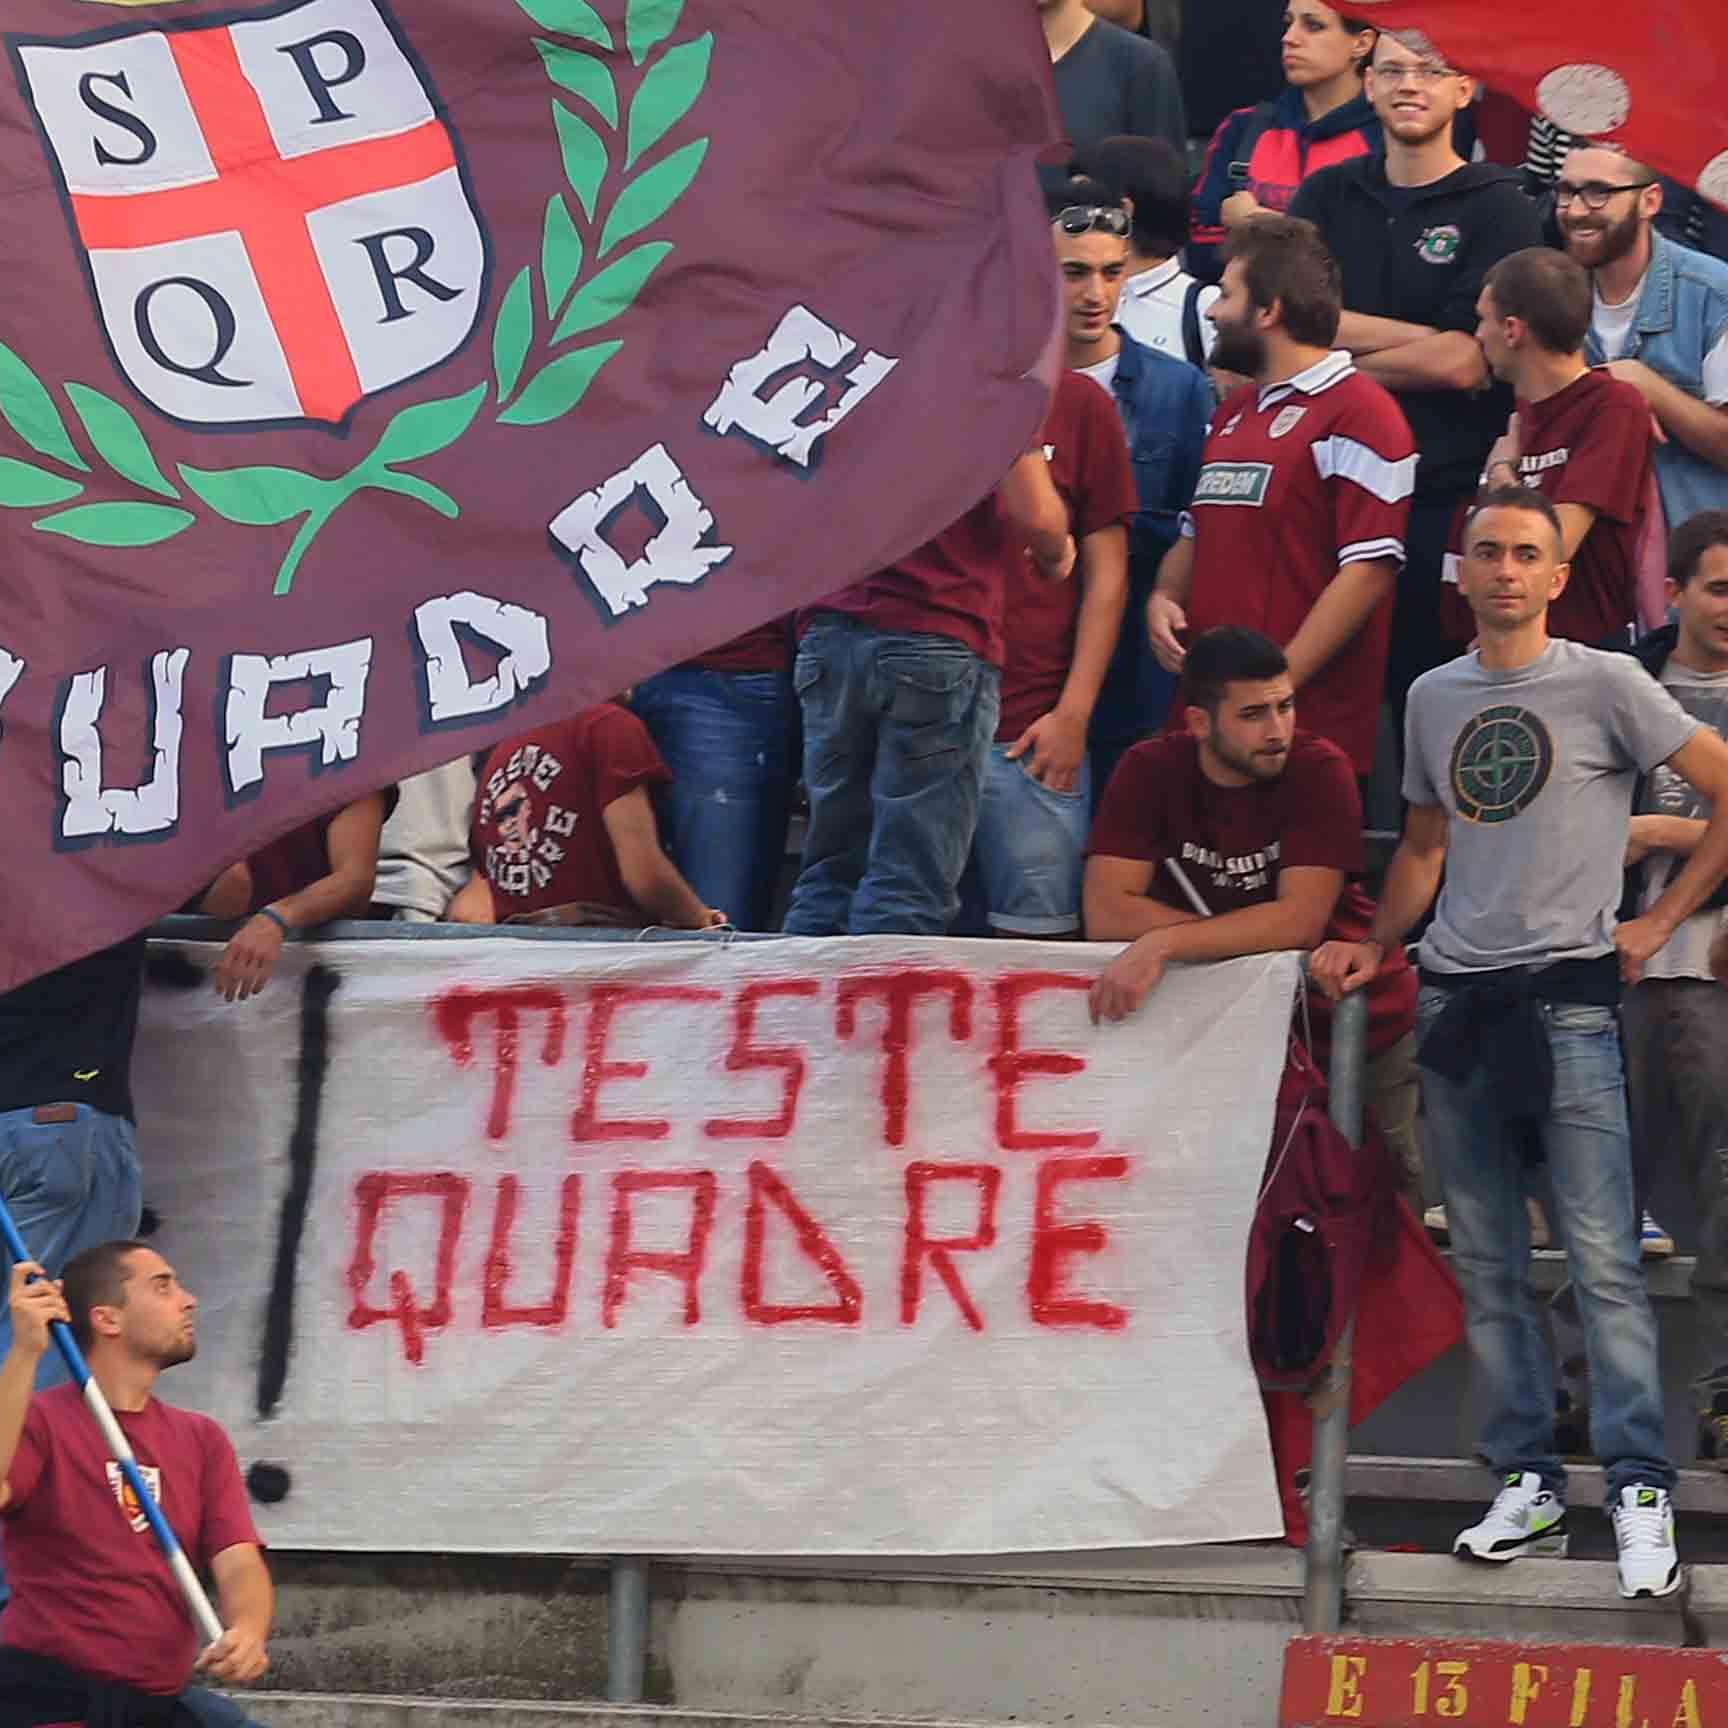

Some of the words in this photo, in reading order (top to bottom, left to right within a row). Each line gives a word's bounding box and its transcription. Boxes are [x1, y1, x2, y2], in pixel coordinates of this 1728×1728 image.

[78, 67, 161, 167] S
[276, 24, 370, 125] P
[132, 271, 251, 390] Q
[354, 221, 467, 328] R
[426, 962, 1100, 1150] TESTE
[345, 1153, 1140, 1368] QUADRE
[1325, 1654, 1367, 1719] E
[1408, 1660, 1470, 1720] 13
[1509, 1661, 1700, 1728] FILA
